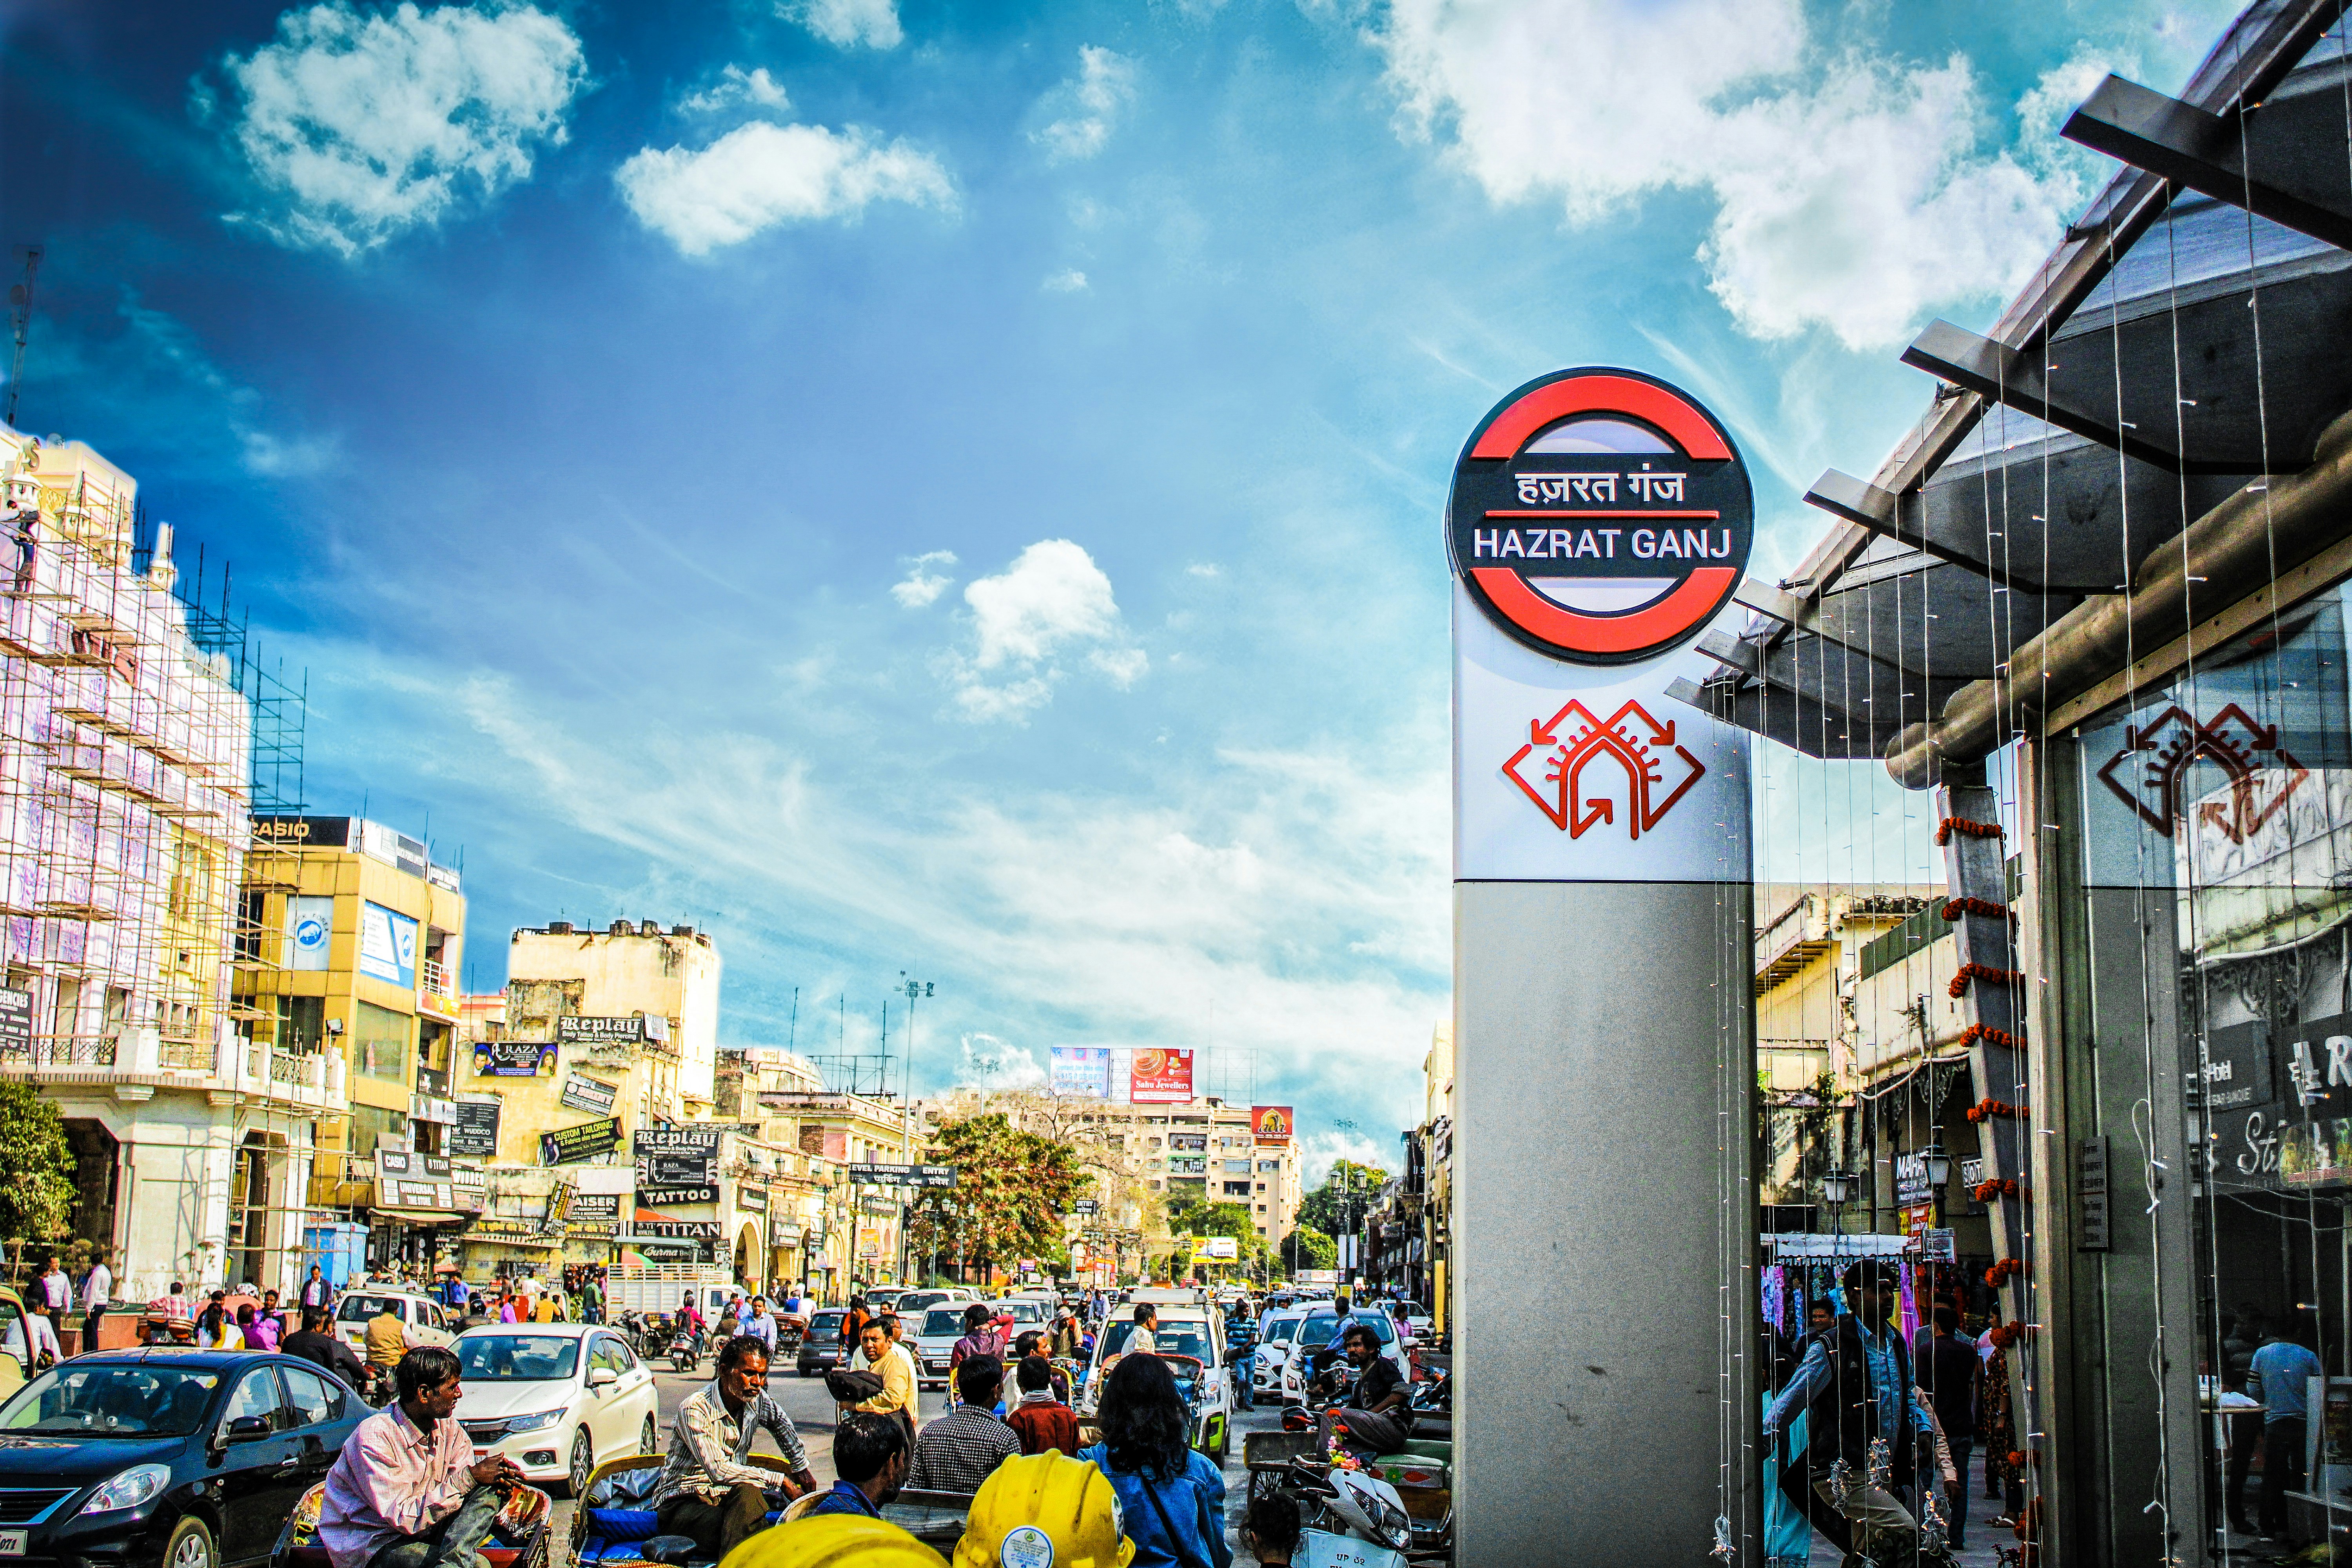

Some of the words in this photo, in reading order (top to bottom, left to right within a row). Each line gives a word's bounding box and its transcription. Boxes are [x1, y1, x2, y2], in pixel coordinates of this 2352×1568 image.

[1515, 473, 1619, 504] हज़रत
[1627, 463, 1687, 503] गंज
[1474, 529, 1621, 559] HAZRAT
[1631, 528, 1731, 559] GANJ
[561, 1016, 641, 1034] Replay
[505, 1045, 539, 1054] RAZA
[1136, 1080, 1154, 1089] Sahu
[1155, 1081, 1189, 1090] Jewellers
[554, 1128, 581, 1142] CUSTOM
[581, 1120, 613, 1134] TAILORING
[636, 1131, 718, 1147] Replay
[385, 1154, 406, 1169] CASIO
[433, 1158, 449, 1170] TITAN
[850, 1163, 872, 1172] EVEL
[874, 1164, 910, 1174] PARKING
[922, 1167, 949, 1175] ENTRY
[399, 1181, 436, 1195] UNIVERSAL
[574, 1196, 616, 1207] AISER
[647, 1189, 711, 1203] TATTOO
[656, 1222, 720, 1236] TITAN
[0, 1538, 18, 1550] 071
[1336, 1553, 1349, 1562] UP
[1354, 1556, 1365, 1566] 32
